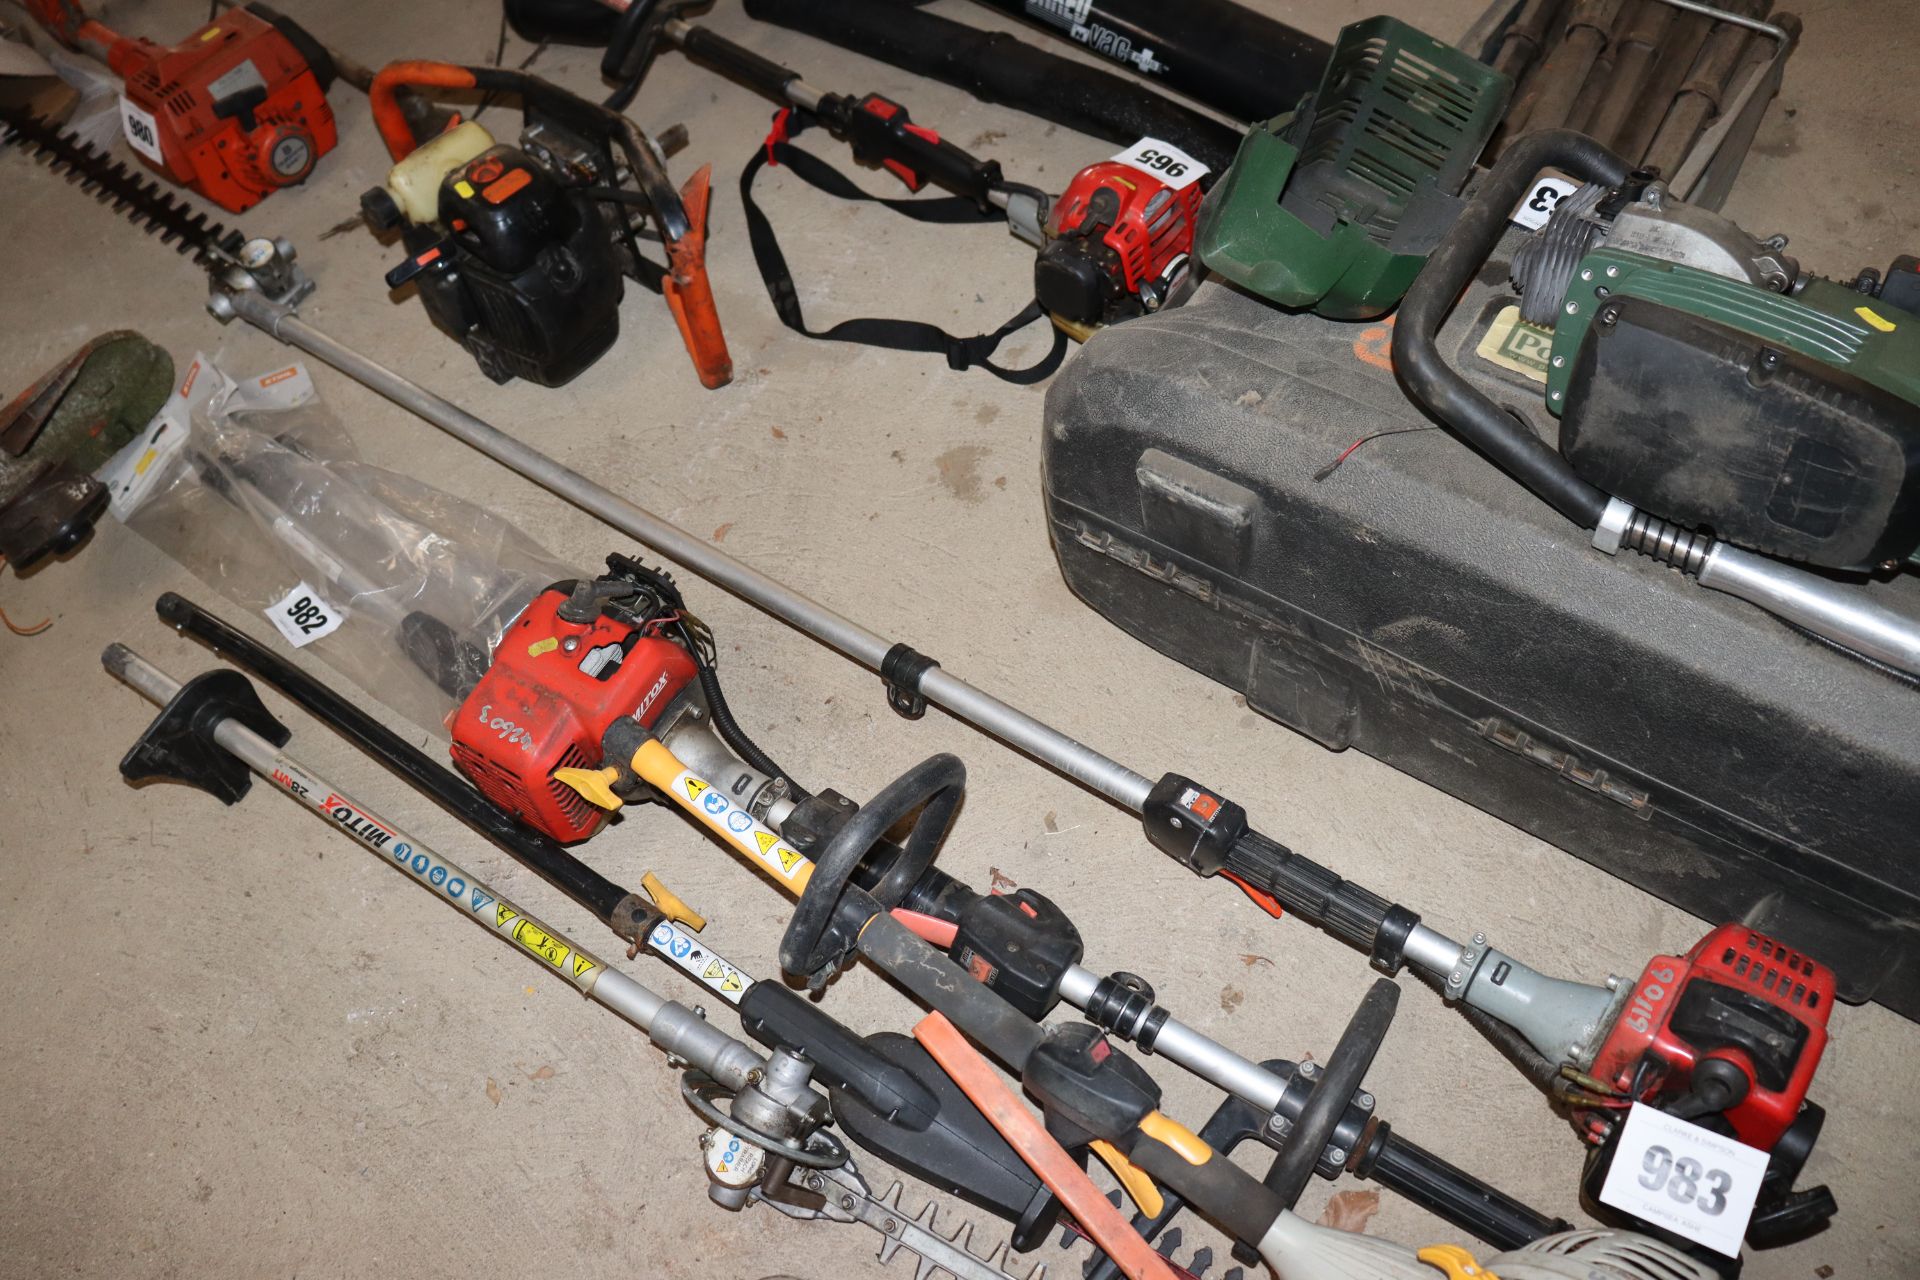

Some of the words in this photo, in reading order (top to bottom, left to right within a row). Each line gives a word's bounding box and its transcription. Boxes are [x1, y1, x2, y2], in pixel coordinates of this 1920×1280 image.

[128, 114, 154, 147] 980
[1135, 149, 1189, 177] 965
[287, 596, 328, 635] 982
[271, 768, 309, 799] 28MT
[319, 795, 392, 848] MITOX
[1637, 1144, 1733, 1217] 983
